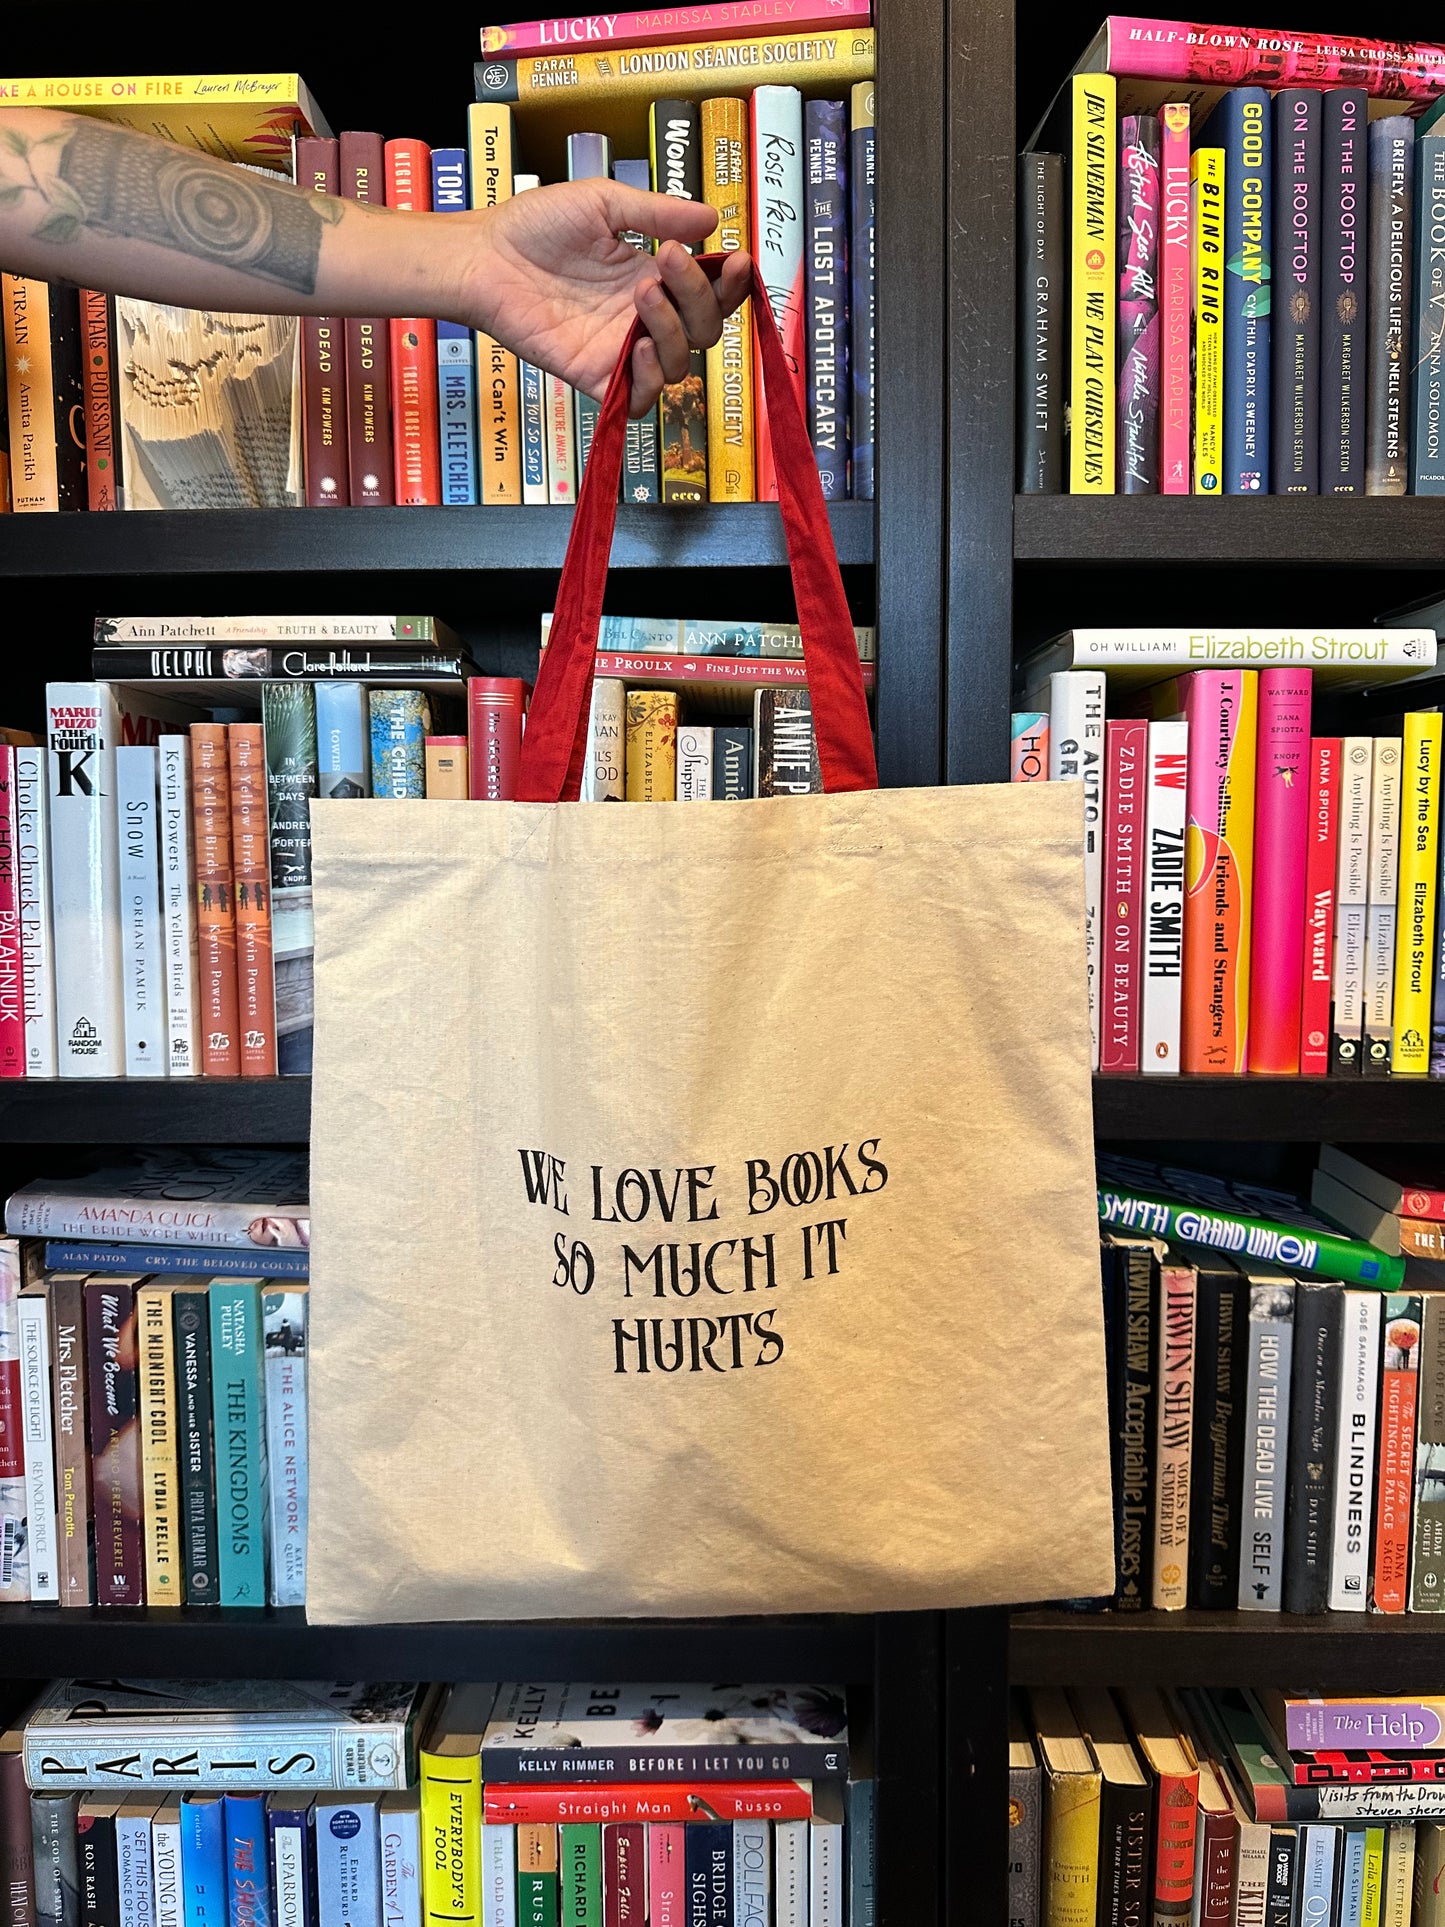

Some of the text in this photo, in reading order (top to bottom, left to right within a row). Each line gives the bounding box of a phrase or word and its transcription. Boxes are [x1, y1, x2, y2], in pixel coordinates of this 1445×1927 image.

[539, 1, 796, 44] LUCKY MARISSA STAPLEY
[531, 71, 579, 87] PENNER
[534, 58, 574, 71] SARAH
[620, 40, 837, 74] LONDON SÉANCE SOCIETY
[28, 79, 281, 96] A HOUSE ON FIRE Lauren McBrayer
[810, 139, 821, 185] PENNER
[824, 140, 835, 182] SARAH
[759, 132, 797, 257] ROSIE PRICE
[1202, 185, 1220, 253] BLING
[1084, 89, 1106, 485] JEN SILVERMAN WE PLAY OURSELVES
[1202, 267, 1218, 325] RING
[1241, 103, 1261, 458] GOOD COMPANY CYNTHIA D'APRIX SWEENEY
[1292, 102, 1307, 473] ON THE ROOFTOP MARGARET WILKERSON SEXTON
[1386, 140, 1404, 459] BRIEFLY, A DELICIOUS LIFE NELL STEVENS
[813, 202, 835, 451] THE LOST APOTHECARY
[1036, 277, 1048, 432] GRAHAM SWIFT
[20, 382, 35, 482] Amita Parikh
[446, 375, 468, 504] MRS. FLETCHER
[1209, 456, 1216, 465] JO
[129, 624, 378, 637] Ann Patchett TRUTH & BEAUTY
[1090, 637, 1389, 659] OH WILLIAM! Elizabeth Strout
[151, 650, 213, 677] DELPHI
[615, 659, 808, 676] PROULX FINE JUST THE WAY
[50, 733, 104, 750] Fourth
[54, 719, 97, 728] PUZO
[59, 729, 88, 739] THE
[56, 752, 108, 797] K
[127, 802, 148, 858] Snow
[1149, 754, 1186, 977] NW ZADIE SMITH
[1410, 739, 1432, 993] Lucy by the Sea Elizabeth Strout
[1113, 747, 1134, 1047] ZADIE SMITH ON BEAUTY
[134, 896, 145, 1011] ORHAN PAMUK
[1312, 890, 1332, 981] Wayward
[518, 1138, 888, 1222] WE LOVE BOOKS
[552, 1219, 847, 1298] SO MUCH IT
[1100, 1194, 1317, 1268] SMITH GRAND UNION
[221, 1305, 232, 1349] PULLEY
[234, 1300, 244, 1355] NATASHA
[612, 1309, 784, 1373] HURTS
[59, 1325, 78, 1434] Mrs. Fletcher
[1164, 1290, 1194, 1456] IRWIN SHAW
[146, 1299, 169, 1569] THE MIDNIGHT COOL LYDIA PEELLE
[1253, 1334, 1279, 1575] HOW THE DEAD LIVE SELF
[227, 1379, 249, 1555] THE KINGDOMS
[1347, 1414, 1366, 1555] BLINDNESS
[1333, 1714, 1424, 1742] The Help
[42, 1750, 316, 1780] PARIS
[519, 1756, 791, 1772] KELLY RIMMER BEFORE I LET YOU GO
[558, 1800, 782, 1817] Straight Man Russo
[1320, 1785, 1415, 1803] Visits from the
[1355, 1804, 1404, 1817] steven
[435, 1826, 447, 1870] FOOL
[450, 1792, 464, 1908] EVERYBODY'S
[1369, 1853, 1378, 1881] Leila
[340, 1845, 349, 1917] RUTHERFURD
[350, 1859, 359, 1903] EDWARD
